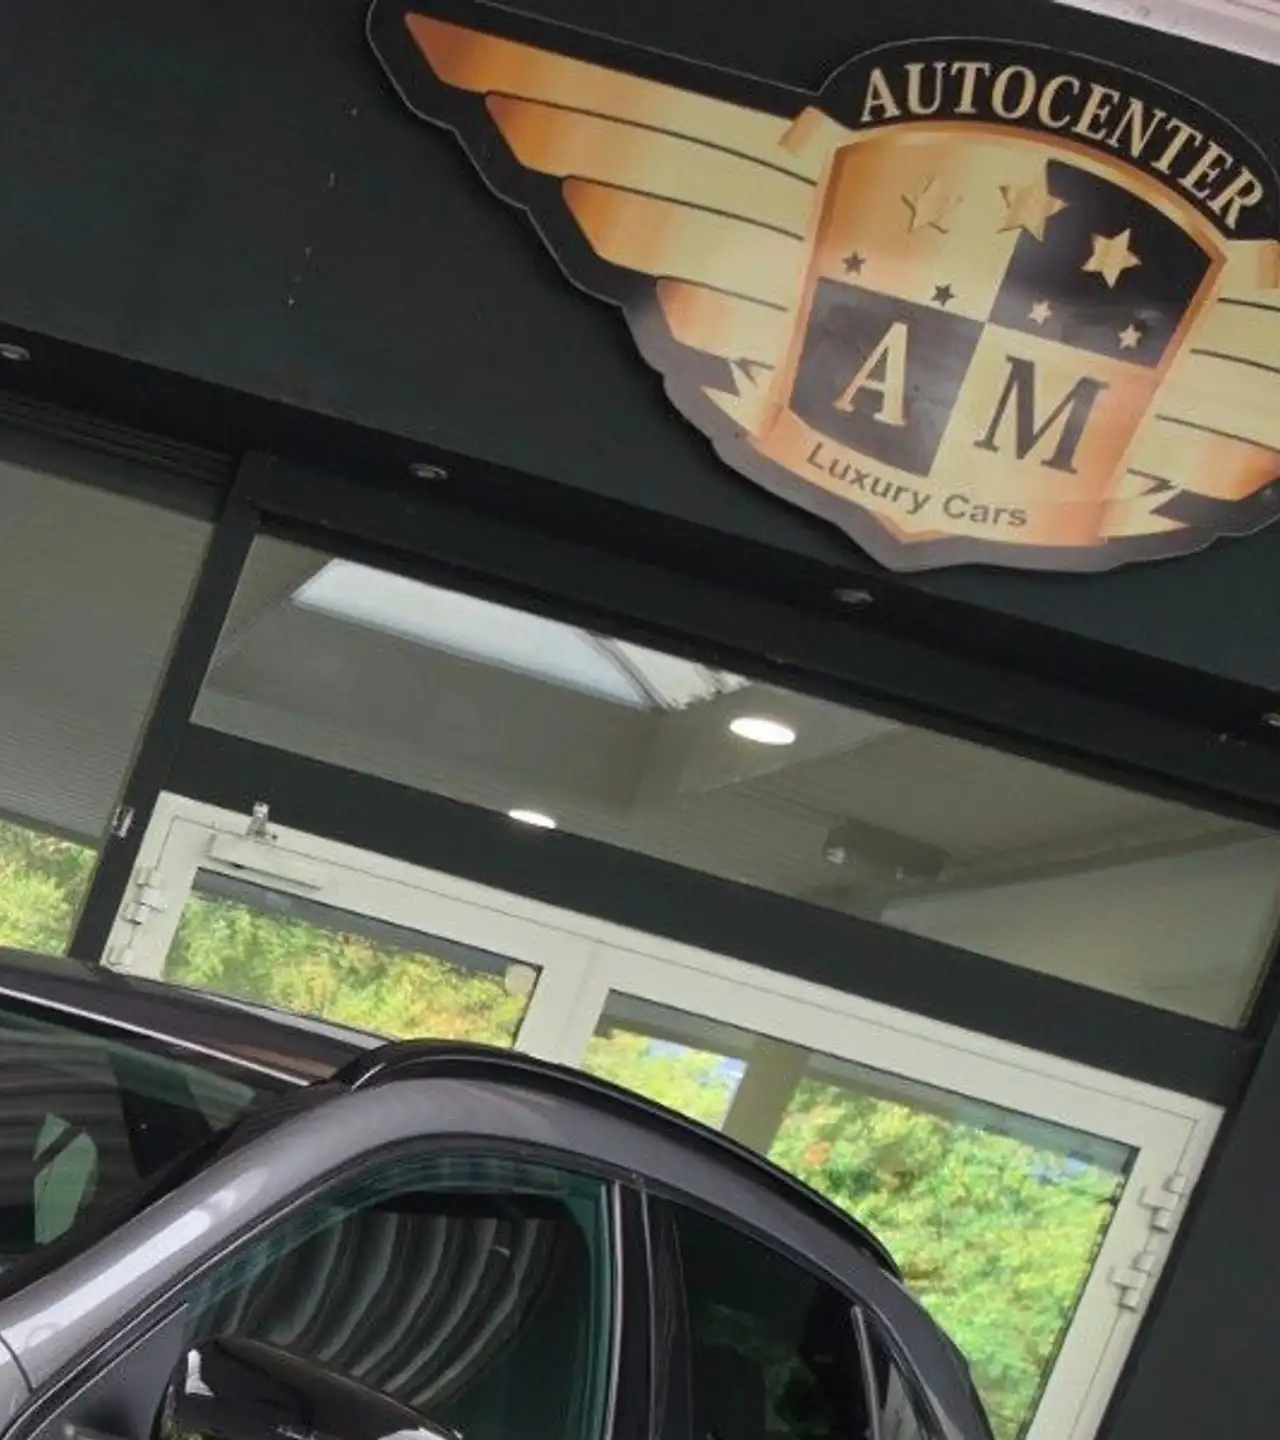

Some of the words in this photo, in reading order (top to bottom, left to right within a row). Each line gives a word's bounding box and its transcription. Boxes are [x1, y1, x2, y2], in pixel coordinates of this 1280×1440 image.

[860, 61, 1264, 230] AUTOCENTER
[832, 321, 908, 426] A
[973, 354, 1110, 474] M
[806, 442, 931, 516] Luxury
[943, 494, 1028, 528] Cars
